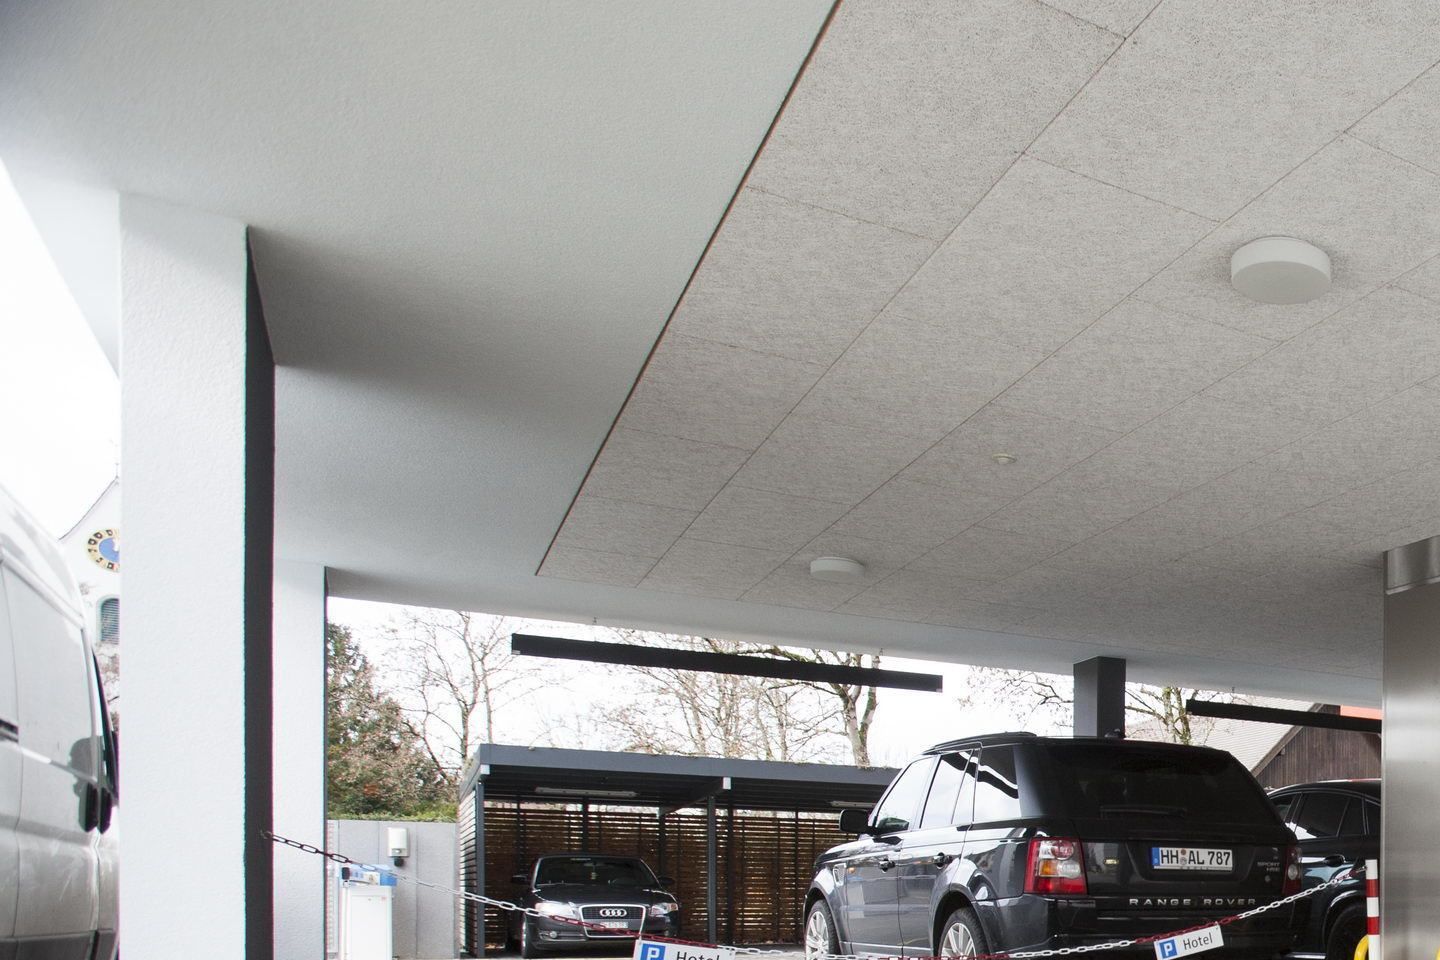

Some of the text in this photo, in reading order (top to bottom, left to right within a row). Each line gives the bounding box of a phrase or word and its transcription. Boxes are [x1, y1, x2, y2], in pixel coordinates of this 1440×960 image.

[1160, 849, 1231, 866] HH AL 787
[1129, 898, 1256, 906] RANGE ROVER
[1182, 932, 1213, 950] Hotel
